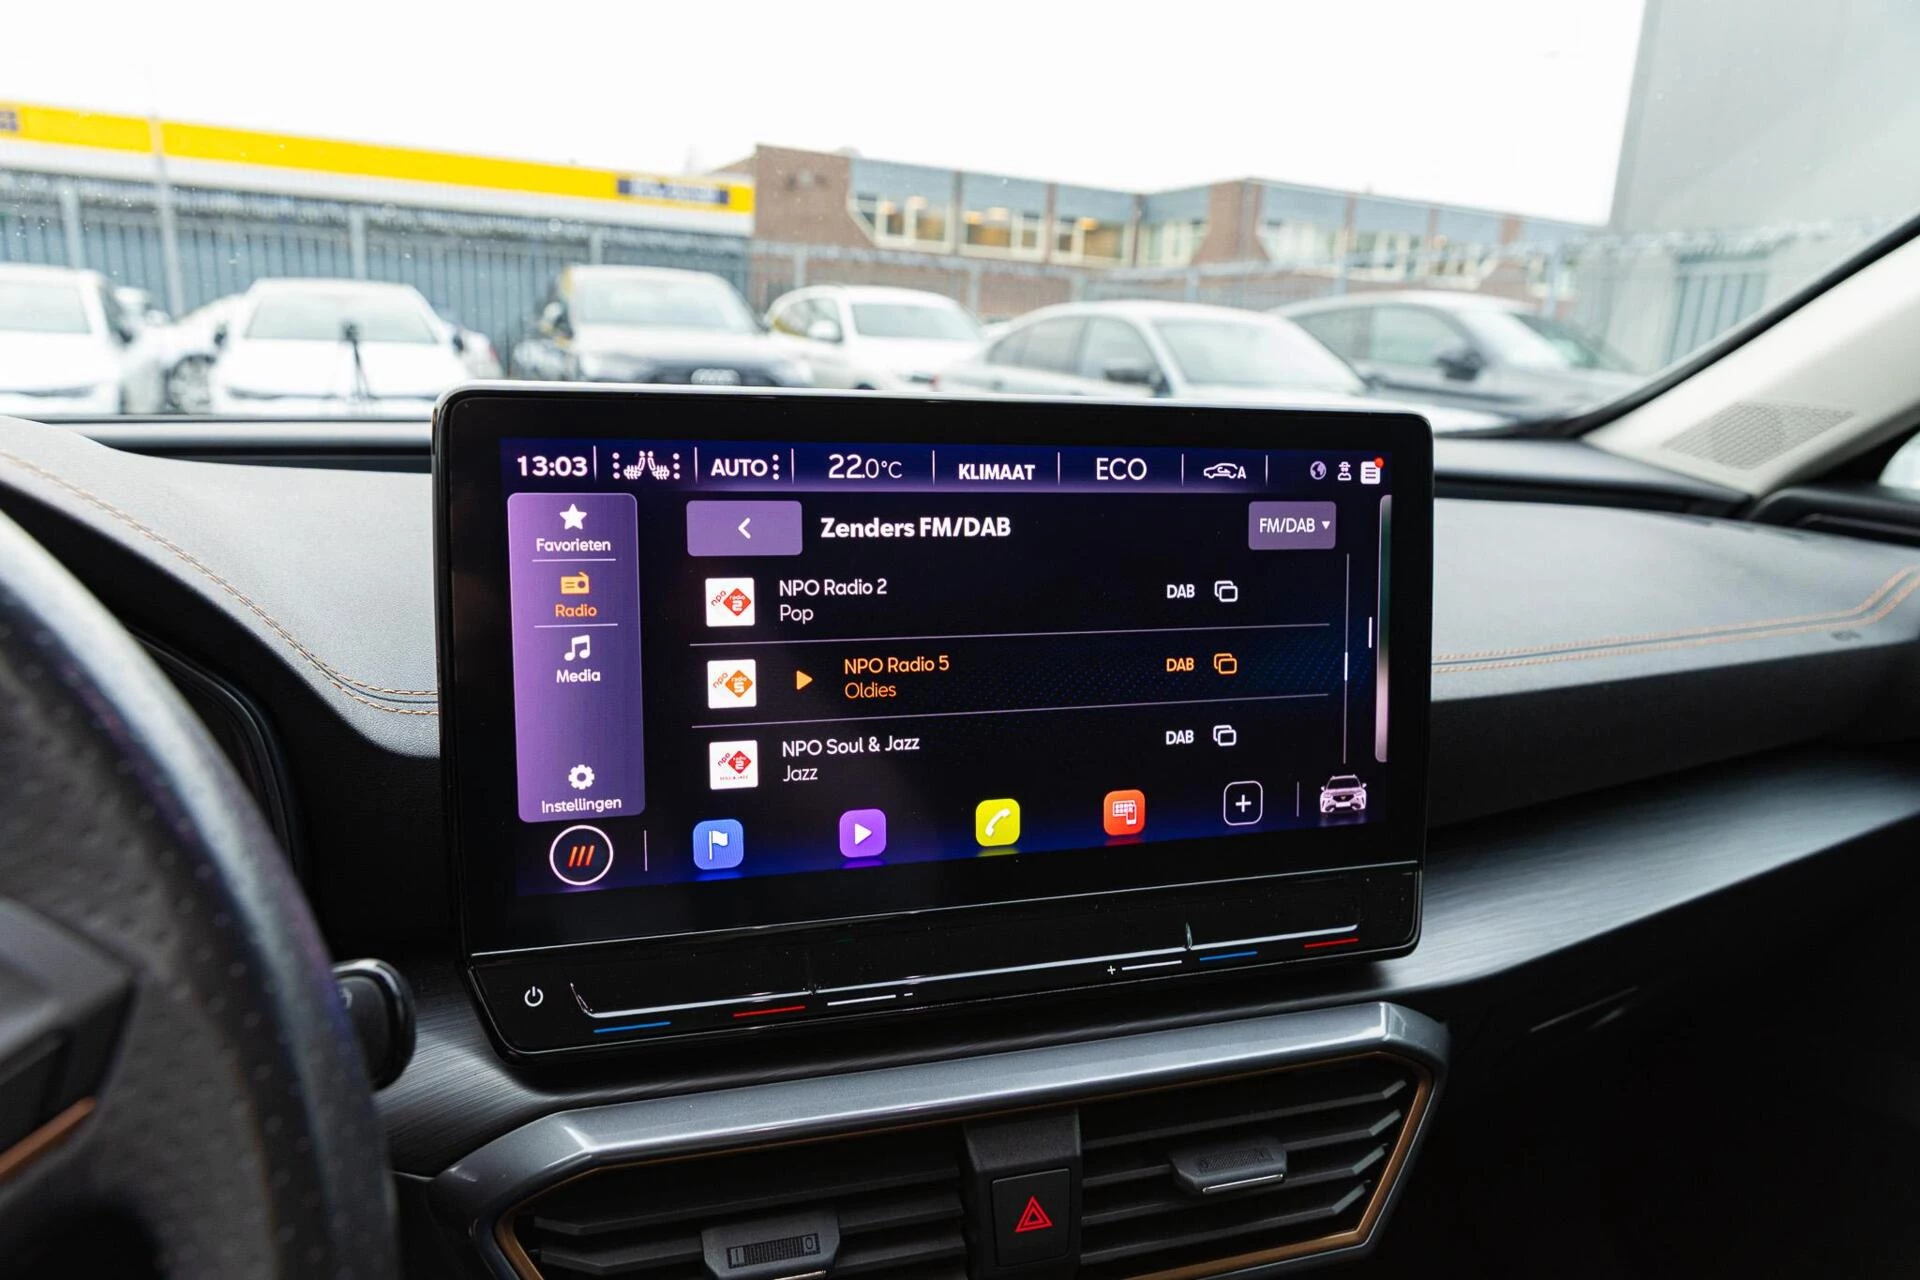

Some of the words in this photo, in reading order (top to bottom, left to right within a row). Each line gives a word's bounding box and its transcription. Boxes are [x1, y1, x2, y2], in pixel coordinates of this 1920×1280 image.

[517, 455, 588, 477] 13:03
[710, 458, 768, 477] AUTO
[958, 463, 1036, 481] KLIMAAT
[1096, 457, 1148, 481] ECO
[820, 517, 915, 538] Zenders
[919, 516, 1012, 538] FM/DAB
[1259, 517, 1316, 534] FM/DAB
[535, 537, 612, 552] Favorieten
[779, 579, 820, 597] NPO
[823, 578, 873, 596] Radio
[876, 577, 888, 595] 2
[1166, 583, 1196, 599] DAB
[554, 602, 598, 618] Radio
[779, 604, 814, 625] Pop
[844, 657, 884, 675] NPO
[887, 655, 935, 673] Radio
[938, 654, 950, 671] 5
[1166, 657, 1195, 672] DAB
[555, 668, 602, 684] Media
[844, 681, 897, 699] Oldies
[1165, 729, 1195, 745] DAB
[782, 740, 823, 758] NPO
[826, 736, 865, 755] Soul
[868, 736, 881, 753] &
[884, 735, 920, 752] Jazz
[782, 764, 818, 782] Jazz
[541, 796, 622, 815] Instellingen
